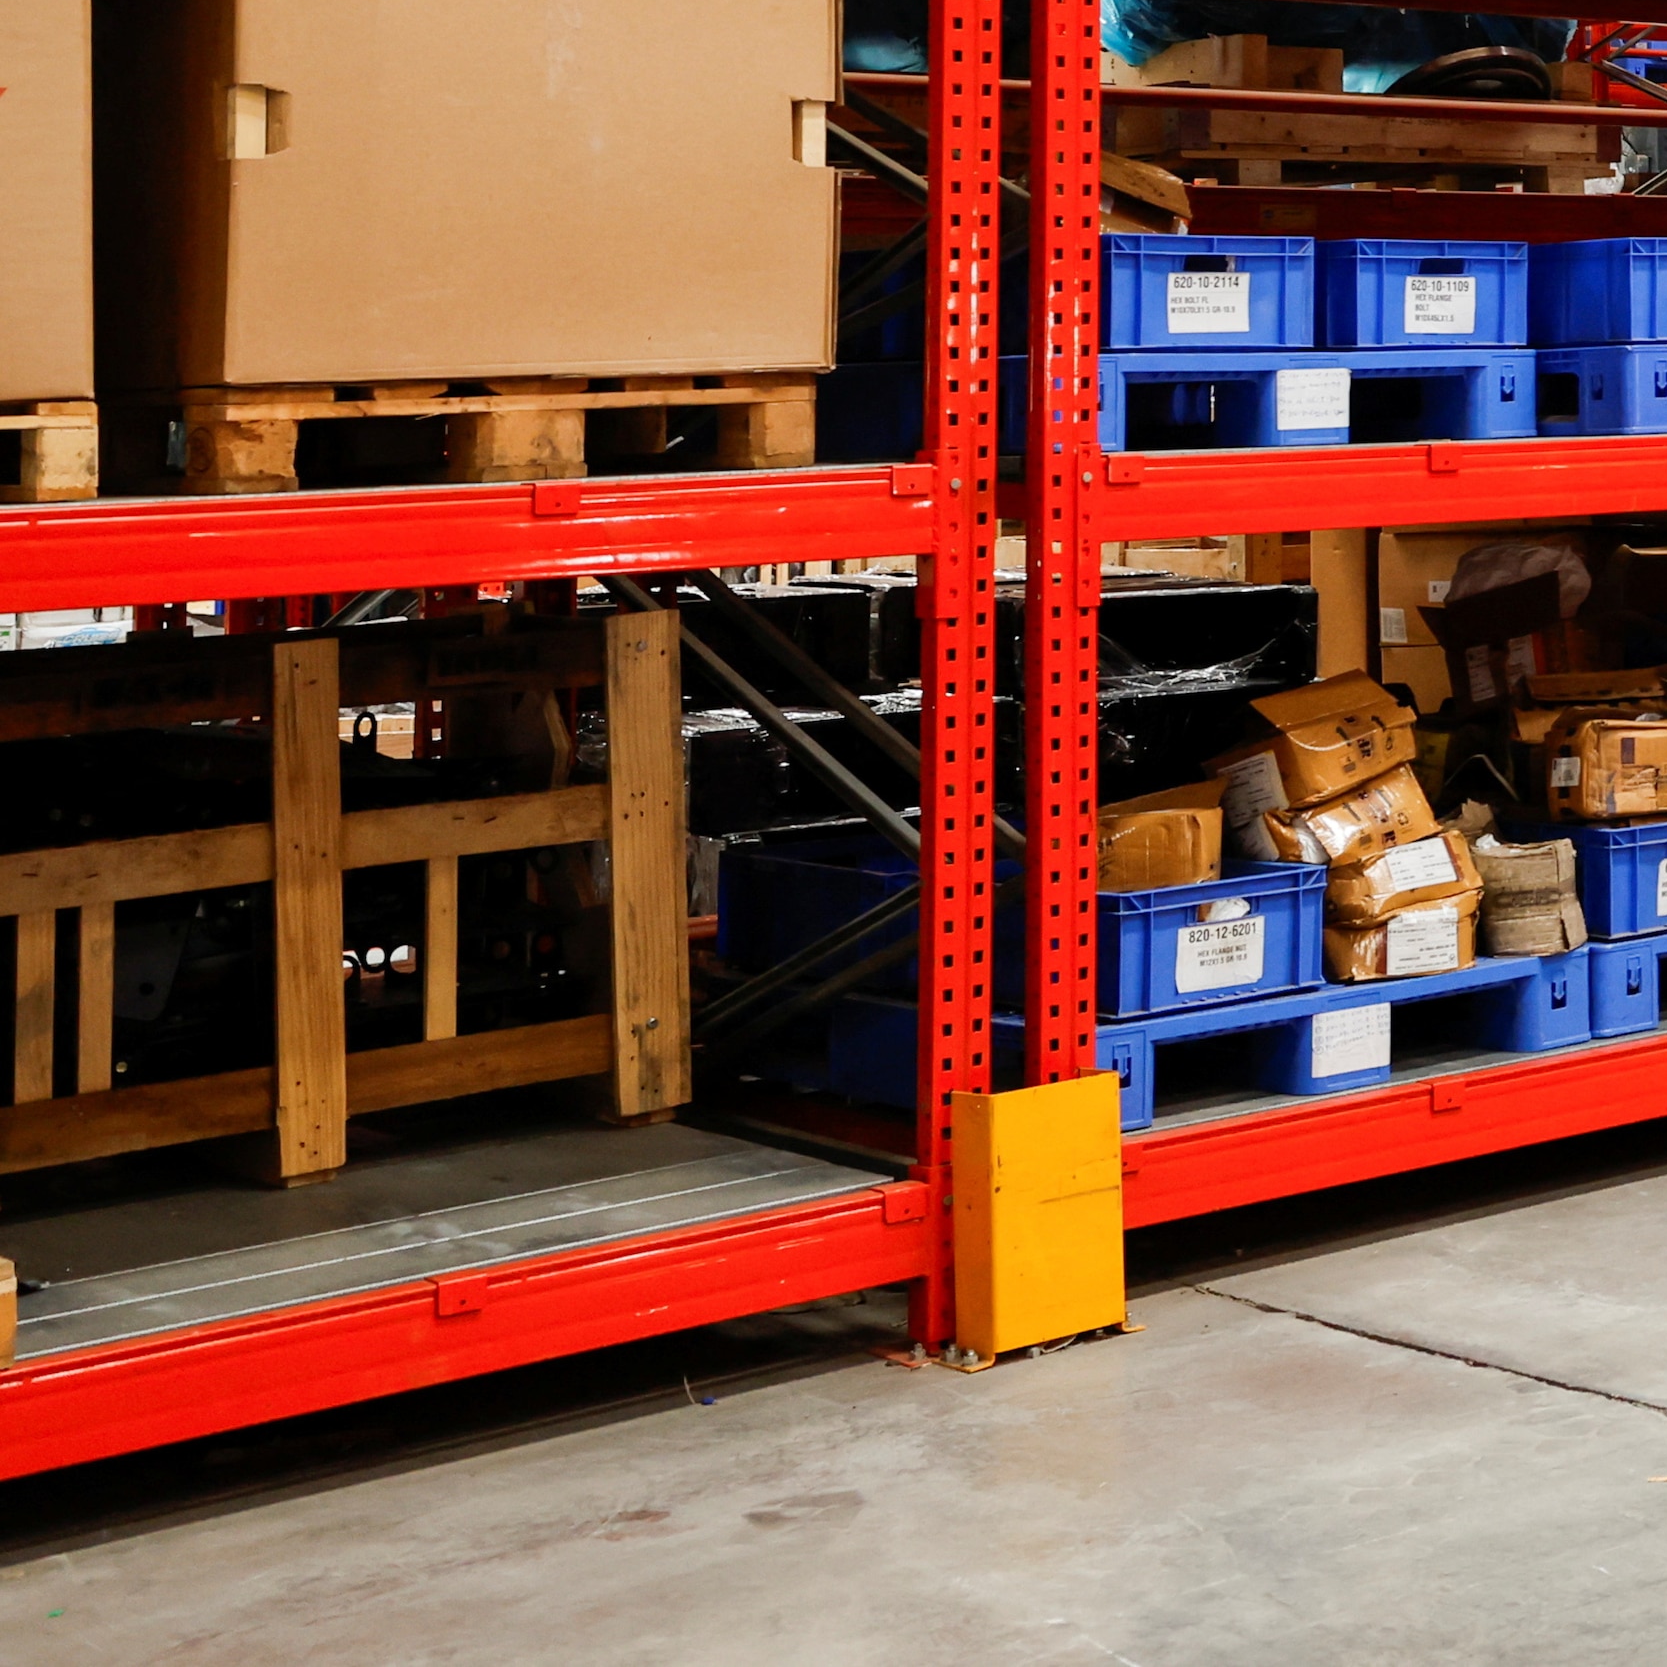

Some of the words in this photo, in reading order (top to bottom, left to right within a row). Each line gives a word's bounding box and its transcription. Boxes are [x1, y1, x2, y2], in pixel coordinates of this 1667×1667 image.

[1173, 276, 1240, 289] 620-10-2114
[1411, 279, 1470, 293] 620-10-1109
[1188, 921, 1258, 944] 820-12-6201
